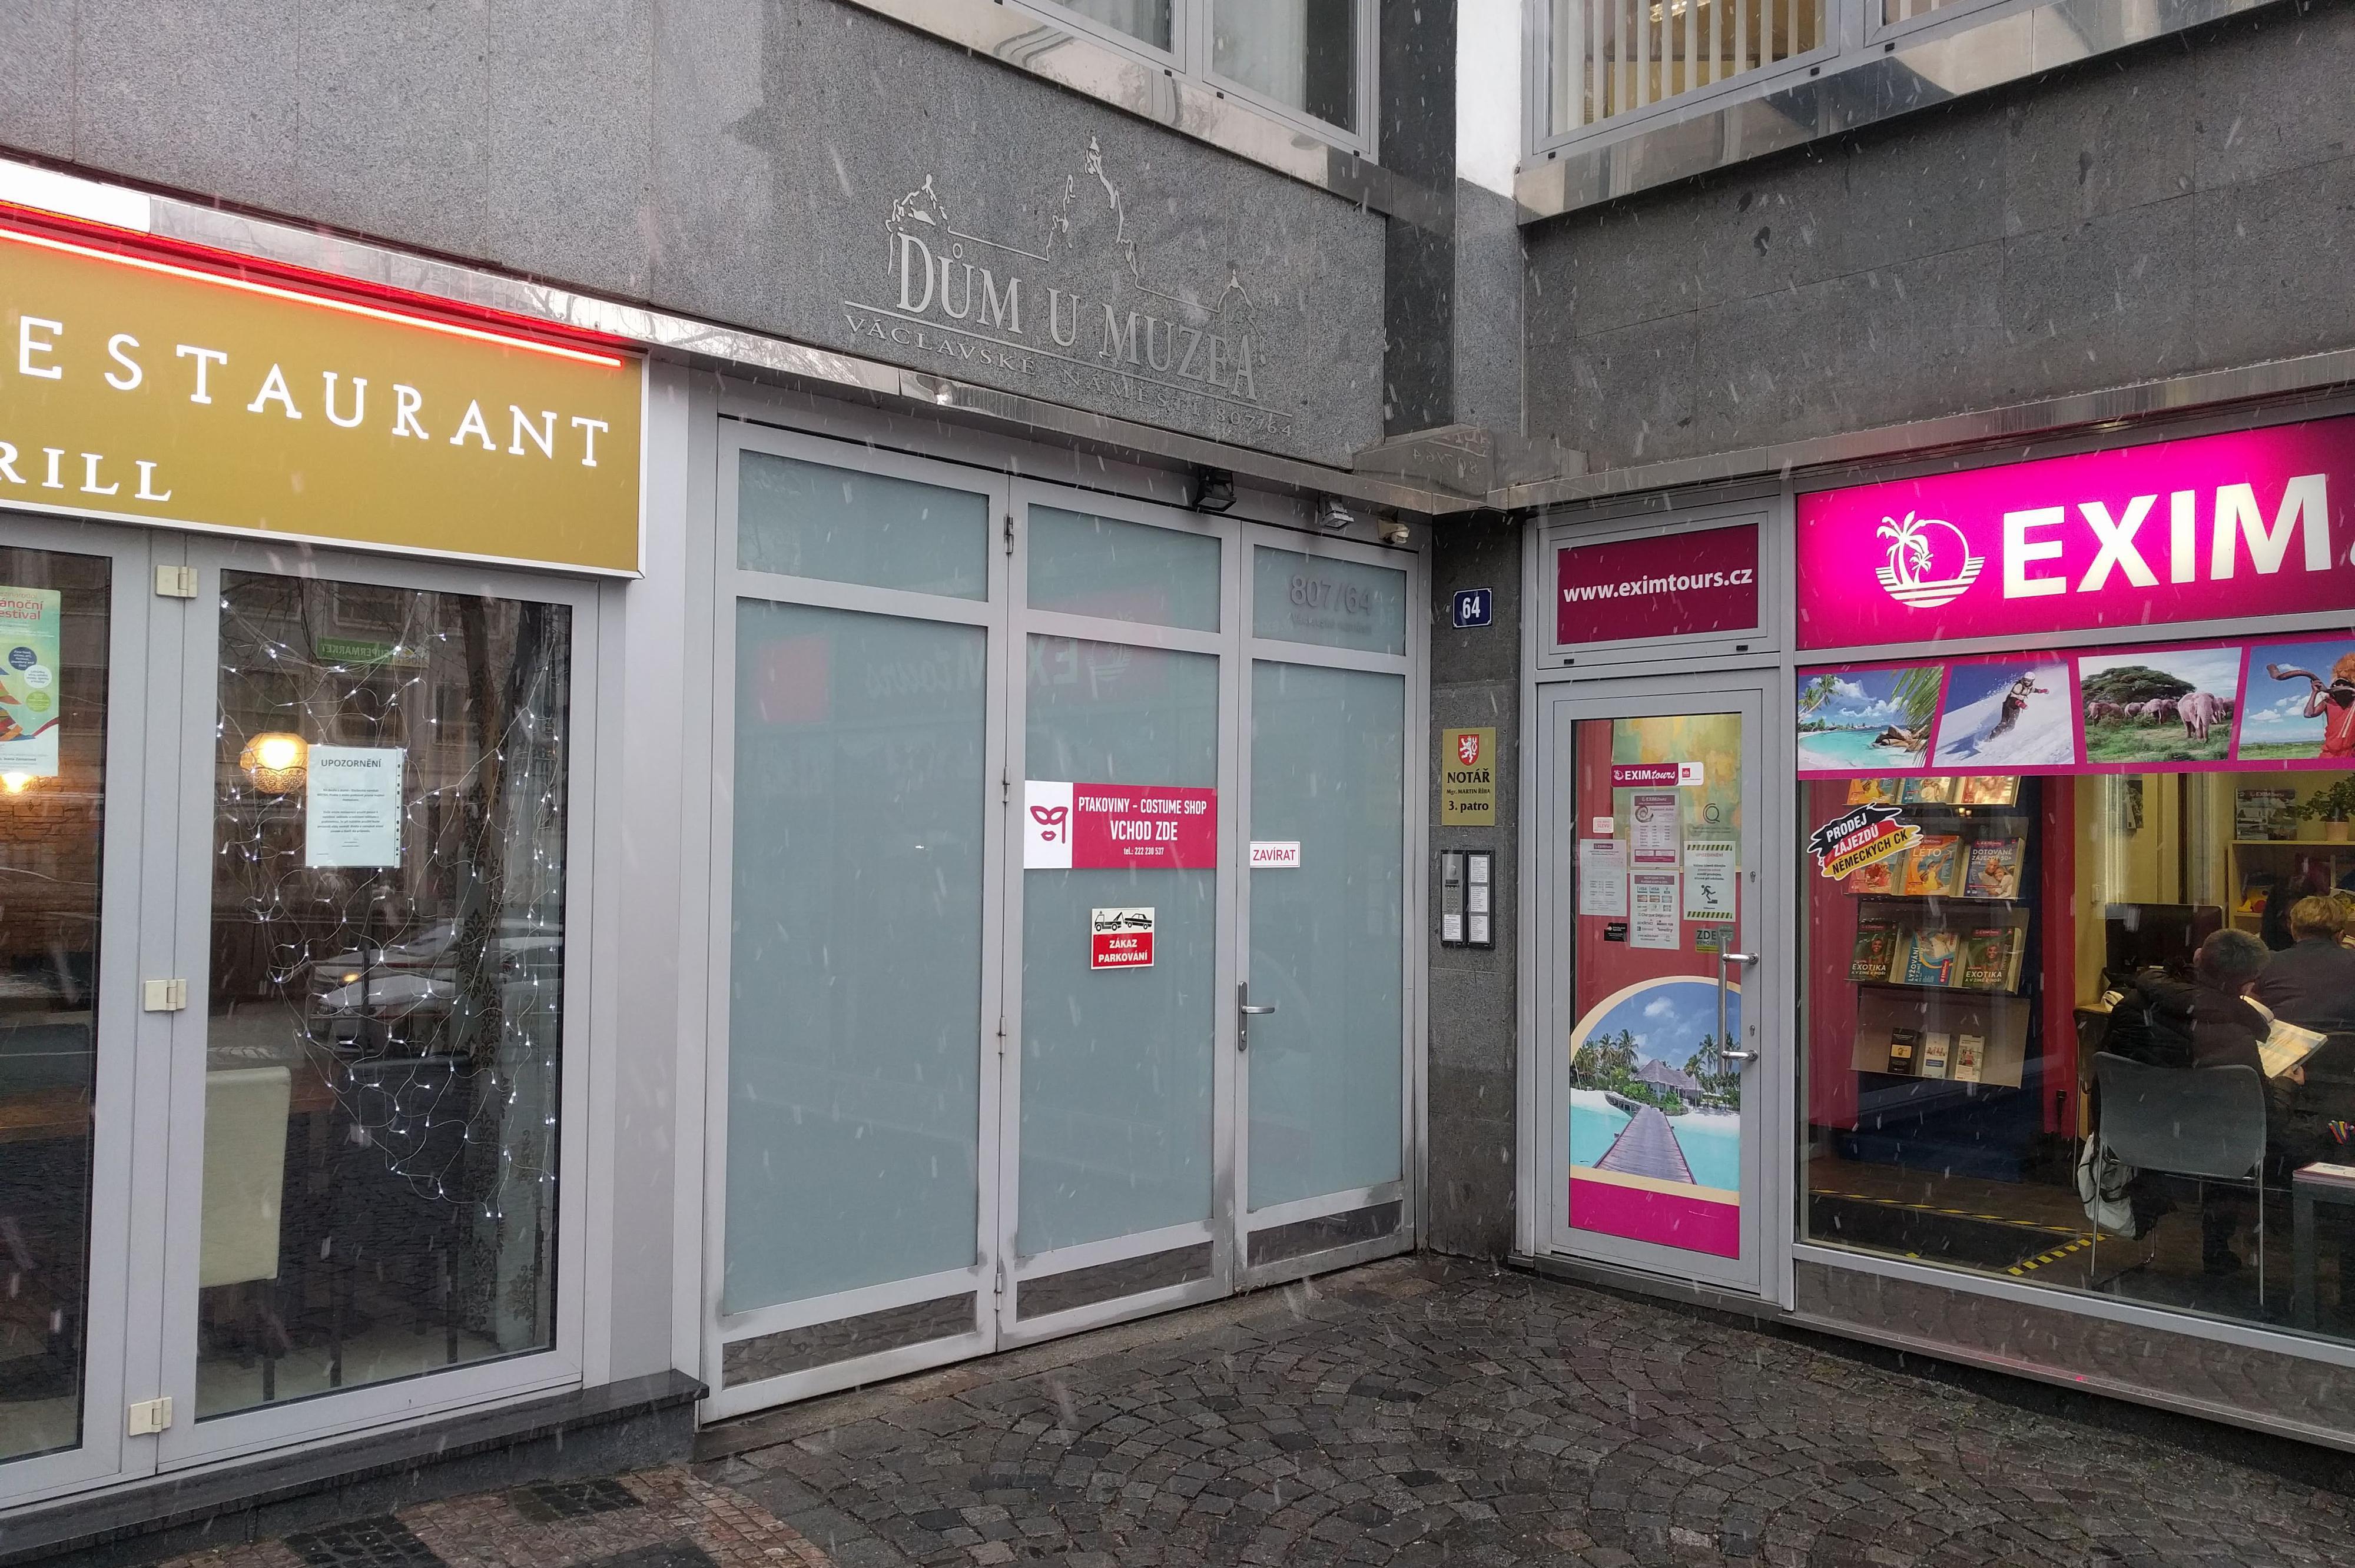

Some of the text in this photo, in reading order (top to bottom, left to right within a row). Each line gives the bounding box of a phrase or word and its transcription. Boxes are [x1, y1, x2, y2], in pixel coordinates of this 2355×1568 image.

[897, 227, 1258, 401] DŮM U MUZEA
[845, 314, 1035, 376] VÁCLAVSKÉ
[1216, 406, 1293, 437] 807/64
[19, 315, 609, 468] ESTAURANT
[1290, 573, 1371, 616] 807/64
[1563, 568, 1753, 603] www.eximtours.cz
[1462, 596, 1481, 619] 64
[321, 758, 382, 768] UPOZORNĚNÍ
[1447, 768, 1490, 784] NOTÁŘ
[1078, 796, 1130, 813] PTAKOVINY
[1140, 798, 1182, 814] COSTUME
[1184, 800, 1207, 815] SHOP
[1448, 800, 1489, 813] 3. patro
[1110, 819, 1178, 841] VCHOD ZDE
[1826, 812, 1868, 843] PRODEJ
[1135, 847, 1144, 855] 222
[1145, 847, 1155, 855] 230
[1155, 847, 1165, 855] 537
[1833, 824, 1879, 858] ZÁJEZDŮ
[1253, 846, 1296, 861] ZAVÍRAT
[1832, 829, 1908, 875] NĚMECKÝCH CK
[1912, 846, 1942, 857] LÉTO
[1109, 938, 1137, 949] ZÁKAZ
[1697, 930, 1717, 940] ZDE
[1098, 950, 1148, 963] PARKOVÁNÍ
